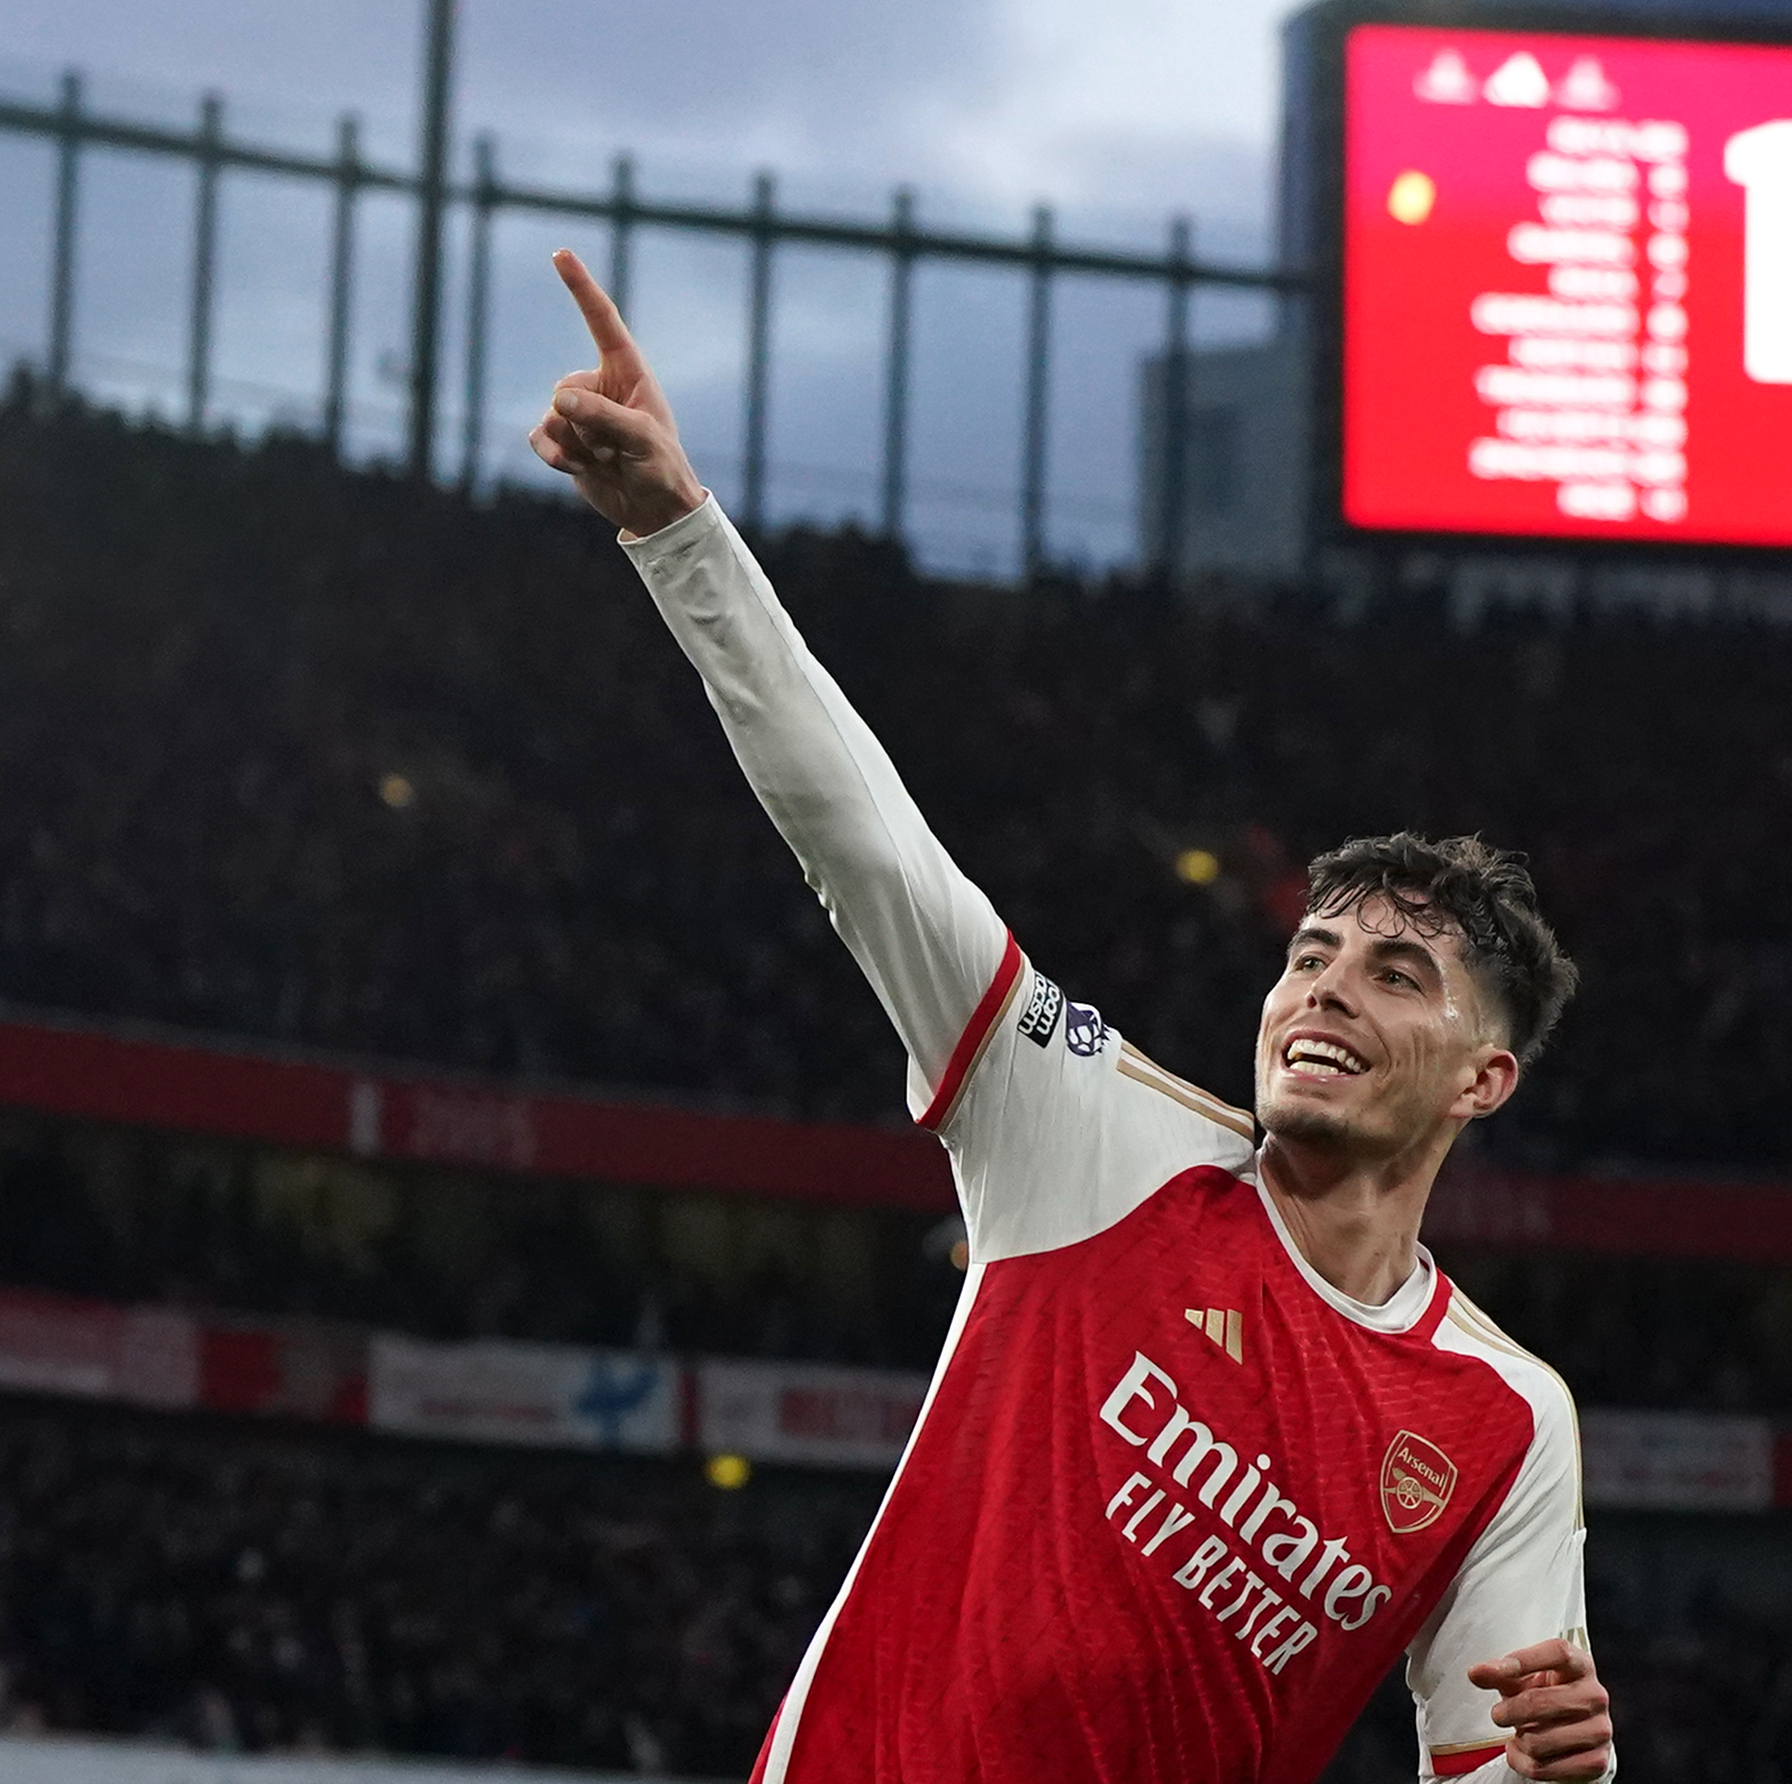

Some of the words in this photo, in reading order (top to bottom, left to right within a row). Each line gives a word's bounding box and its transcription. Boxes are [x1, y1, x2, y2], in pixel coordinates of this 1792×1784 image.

[1099, 1350, 1393, 1631] Emirates
[1397, 1446, 1446, 1488] Arsenal
[1104, 1470, 1196, 1558] FLY
[1172, 1534, 1318, 1676] BETTER
